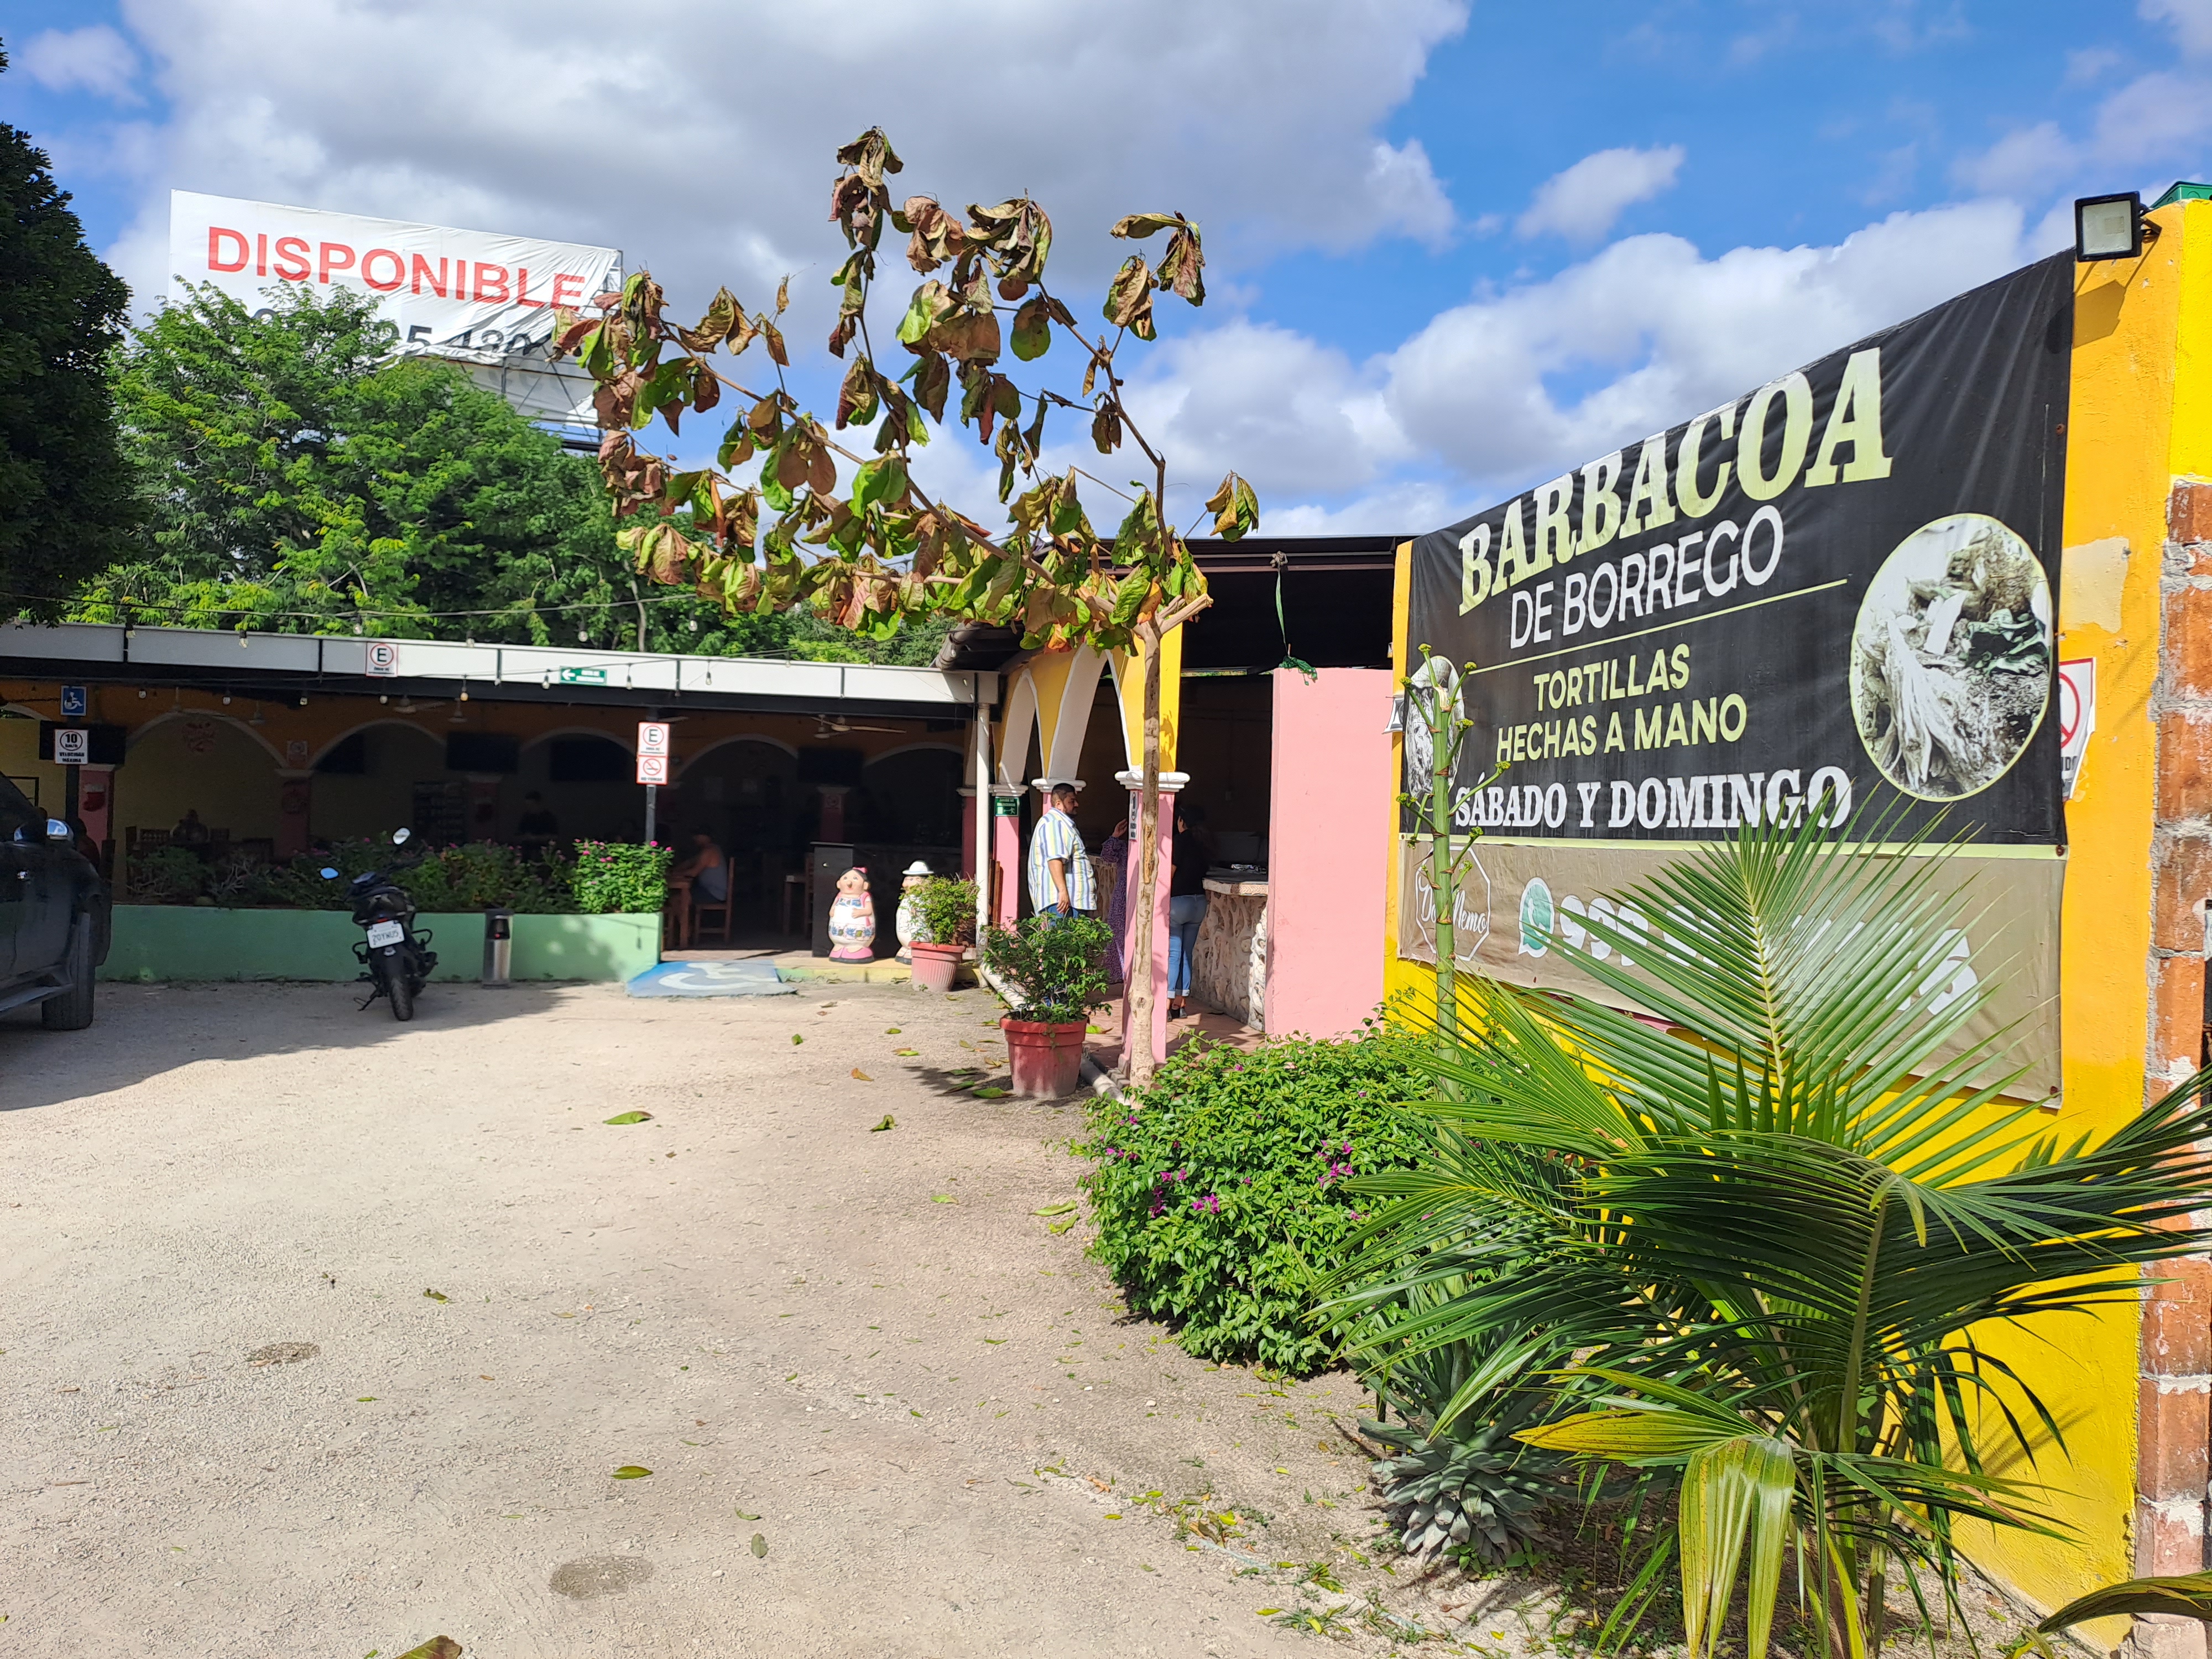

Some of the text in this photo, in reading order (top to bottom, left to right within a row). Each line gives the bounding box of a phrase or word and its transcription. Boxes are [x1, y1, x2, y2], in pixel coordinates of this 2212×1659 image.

[208, 226, 586, 311] DISPONIBLE
[1459, 347, 1893, 617] BARBACOA
[1510, 505, 1784, 649] DE BORREGO
[377, 648, 387, 662] E
[1533, 643, 1690, 711] TORTILLAS
[65, 733, 77, 743] 10
[649, 729, 658, 742] E
[1497, 693, 1747, 762] HECHAS A MANO
[1454, 766, 1851, 830] SÁBADO Y DOMINGO
